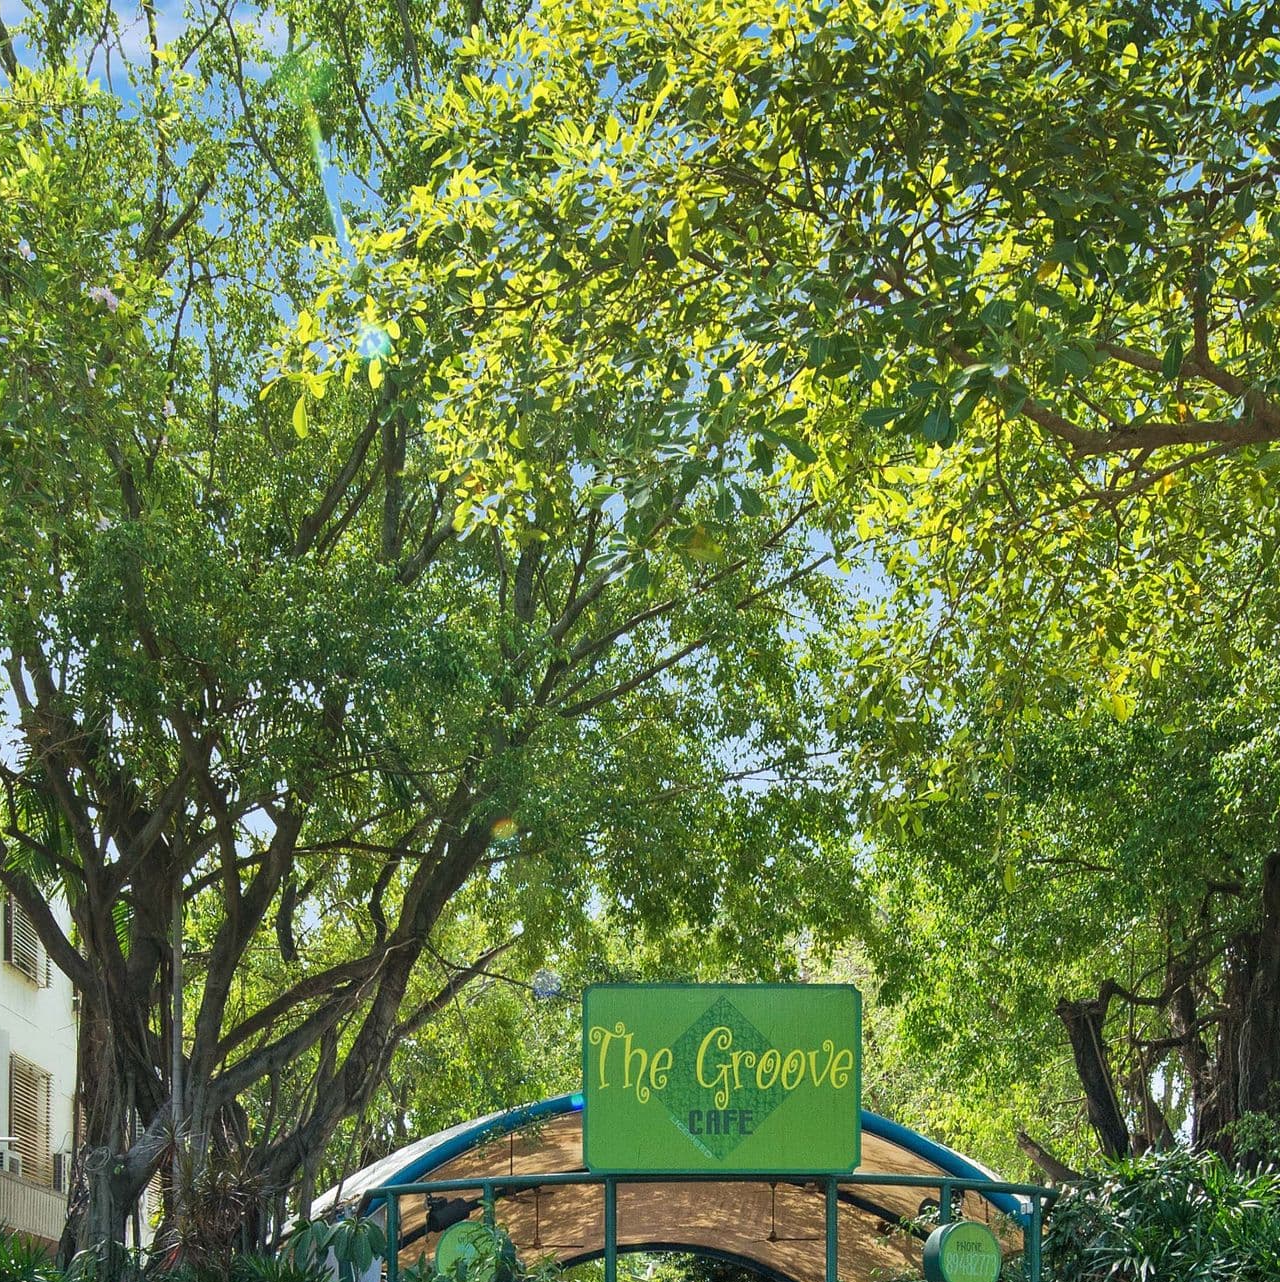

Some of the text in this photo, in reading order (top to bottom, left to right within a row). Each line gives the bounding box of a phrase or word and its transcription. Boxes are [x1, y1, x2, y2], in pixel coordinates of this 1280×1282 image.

[589, 1022, 854, 1110] The Groove
[689, 1109, 754, 1136] CAFE
